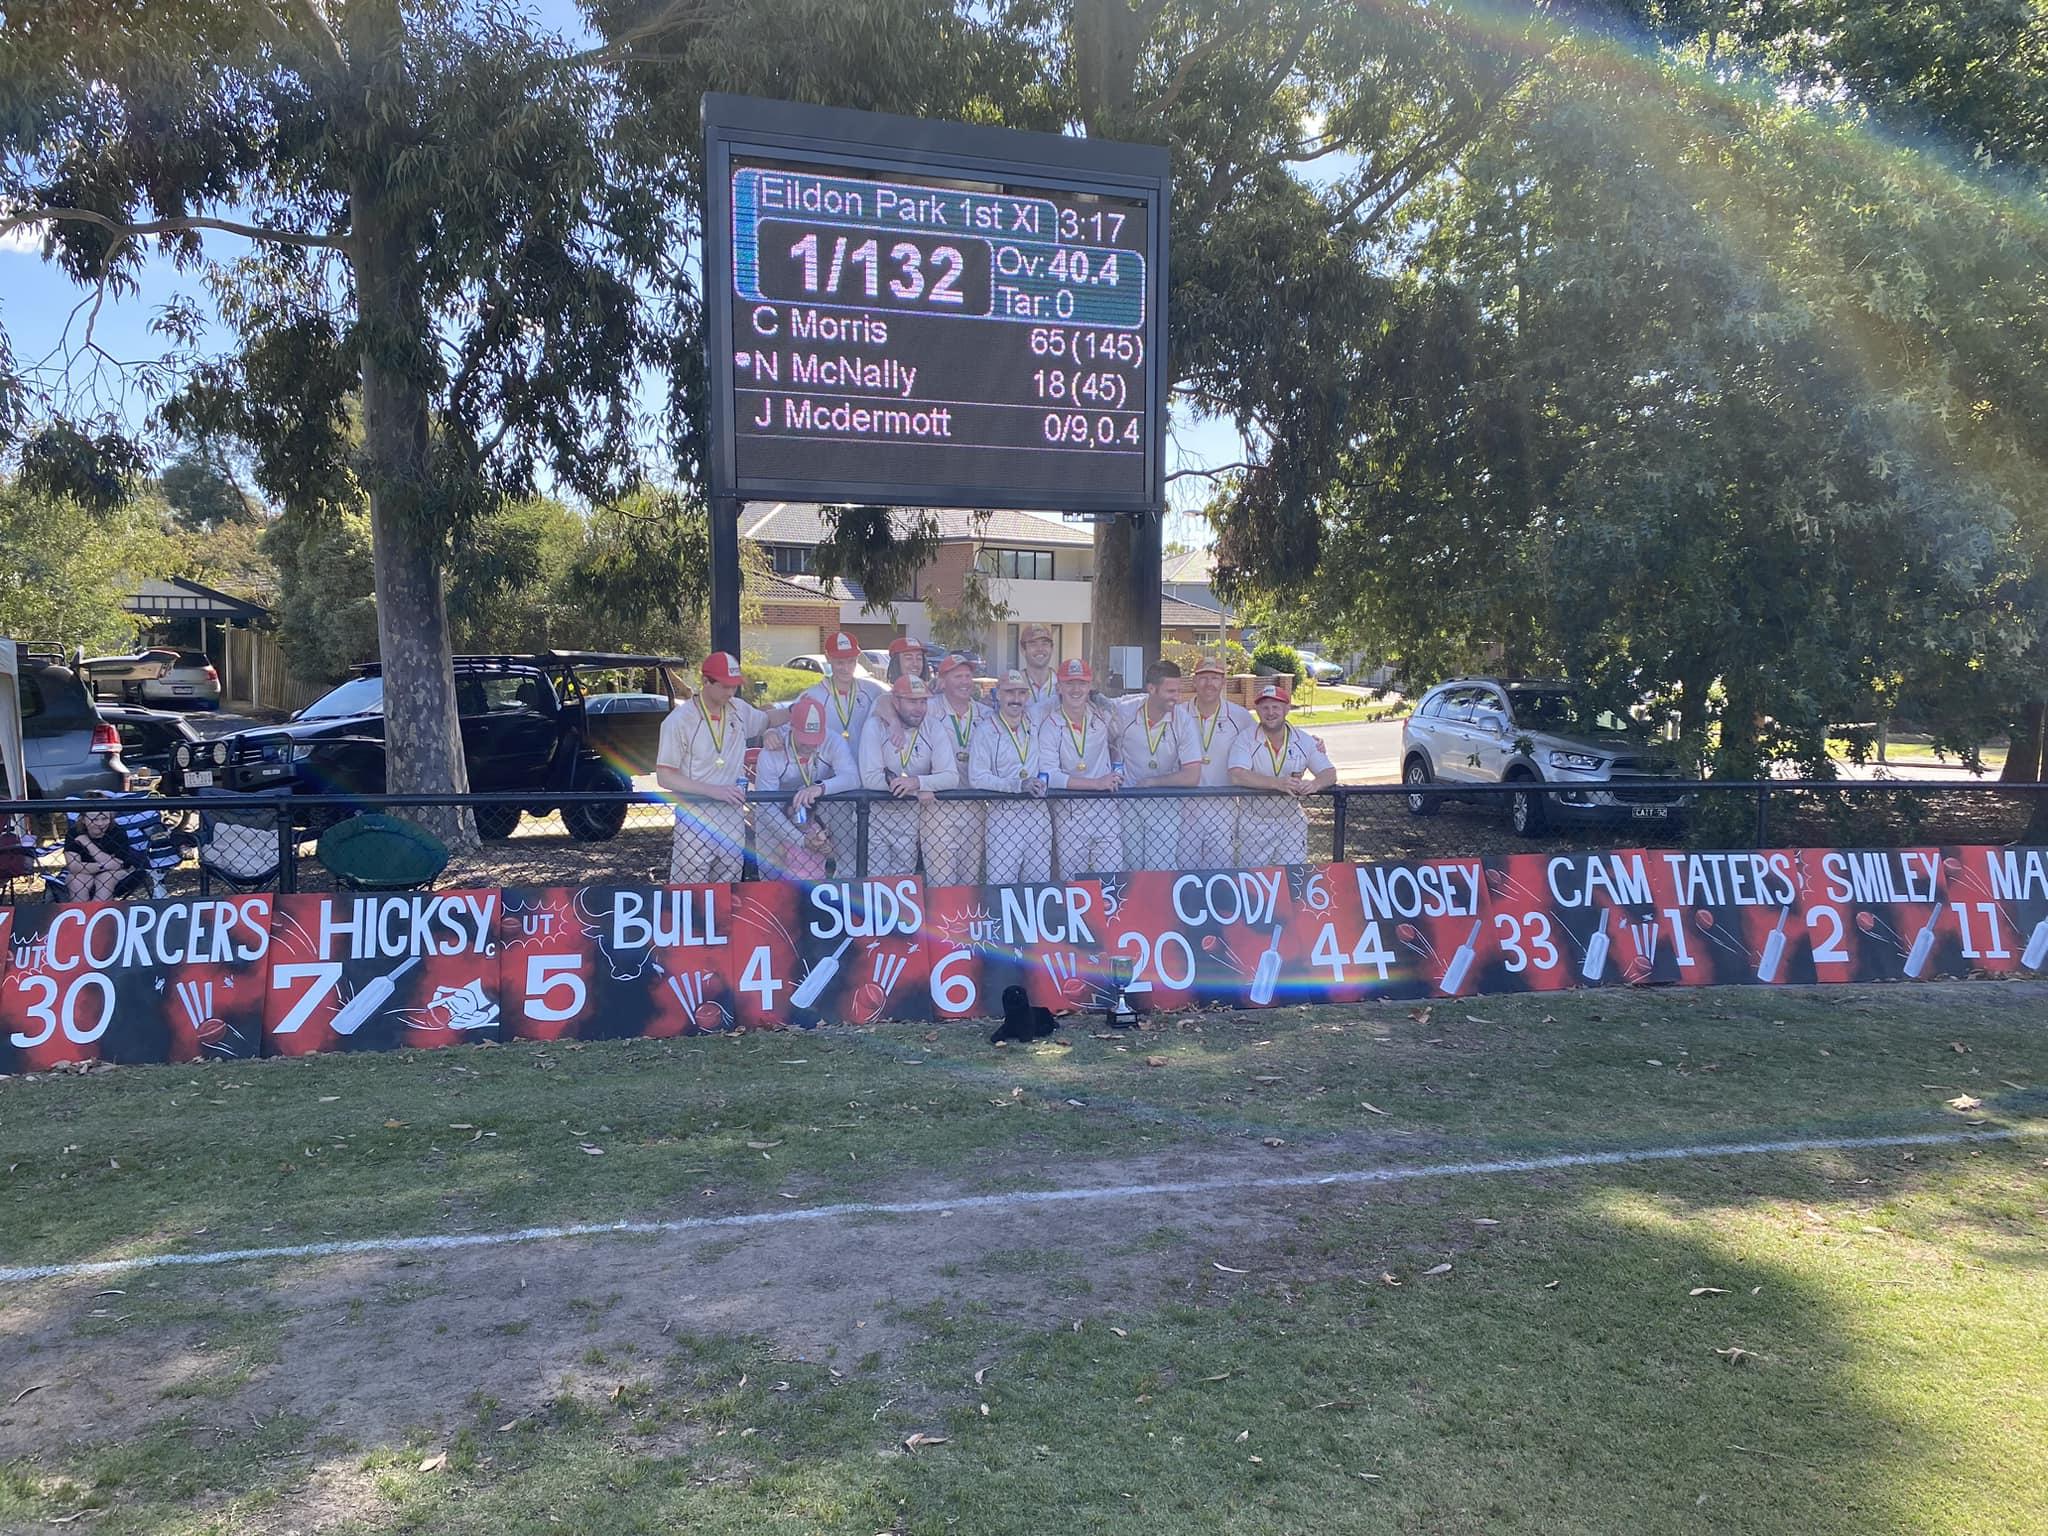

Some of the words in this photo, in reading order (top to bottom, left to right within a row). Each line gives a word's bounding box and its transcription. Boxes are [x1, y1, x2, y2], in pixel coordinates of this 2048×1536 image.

[761, 177, 863, 218] Eildon
[877, 189, 947, 223] Park
[960, 199, 1003, 231] 1st
[1012, 203, 1040, 233] XI
[1060, 210, 1126, 243] 3:17
[789, 232, 965, 304] 1/132
[753, 305, 780, 336] C
[791, 308, 888, 344] Morris
[754, 350, 779, 381] N
[793, 352, 917, 397] McNally
[755, 396, 772, 428] J
[785, 399, 952, 437] Mcdermott
[1044, 415, 1140, 447] 0/9,0.4
[1171, 870, 1282, 927] CODY
[1306, 873, 1330, 910] 6
[1355, 862, 1480, 921] NOSEY
[1547, 852, 1653, 908] CAM
[1663, 852, 1797, 907] TATERS
[1822, 851, 1941, 904] SMILEY
[1985, 850, 2048, 901] MA
[47, 898, 270, 972] CORCERS
[320, 894, 497, 956] HICKSY
[612, 888, 728, 950] BULL
[809, 878, 924, 940] SUDS
[1000, 886, 1096, 945] NCR
[1663, 908, 1696, 967] 1
[1806, 904, 1850, 963] 2
[1951, 902, 2012, 959] 11
[1116, 930, 1197, 994] 20
[1310, 921, 1397, 983] 44
[1494, 910, 1559, 973] 33
[272, 962, 343, 1034] 7
[523, 953, 587, 1022] 5
[738, 945, 783, 1011] 4
[929, 949, 977, 1014] 6
[10, 971, 116, 1049] 30
